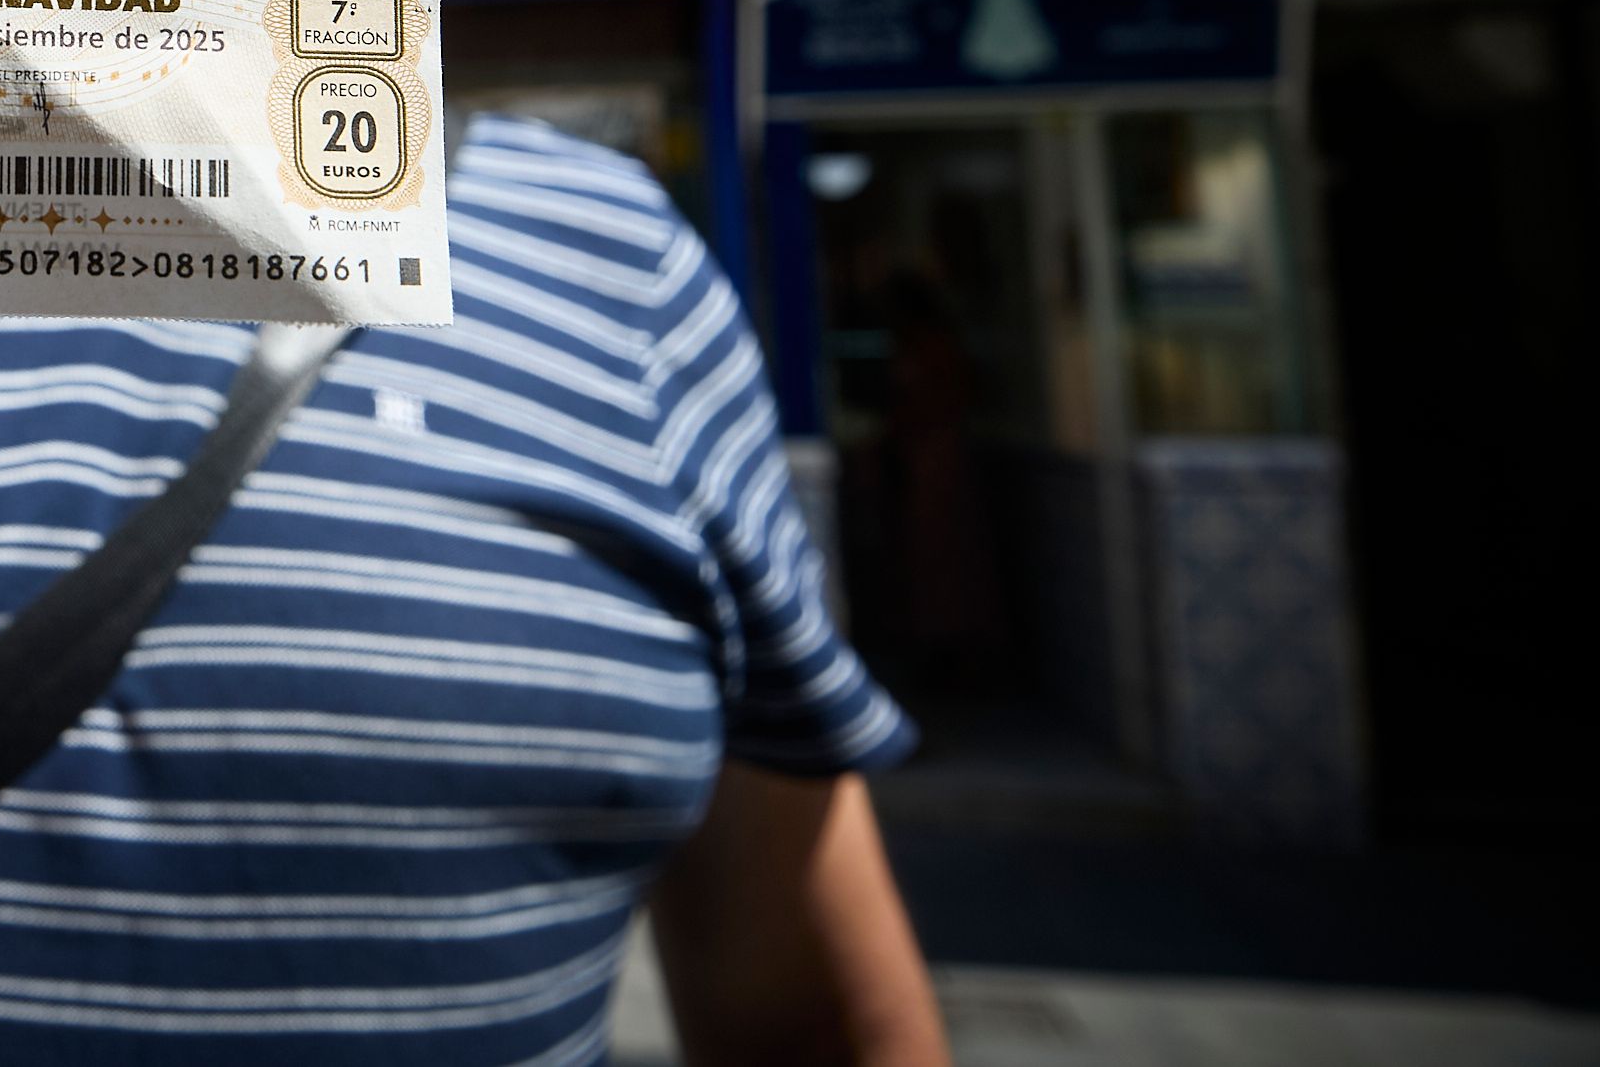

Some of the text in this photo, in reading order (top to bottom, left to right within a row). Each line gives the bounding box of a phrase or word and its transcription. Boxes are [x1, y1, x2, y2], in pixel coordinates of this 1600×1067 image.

[115, 24, 148, 50] de
[159, 28, 225, 52] 2025
[304, 28, 388, 45] FRACCIÓN
[320, 82, 377, 98] PRECIO
[321, 110, 377, 153] 20
[323, 164, 382, 179] EUROS
[328, 219, 400, 232] RCM-FNMT
